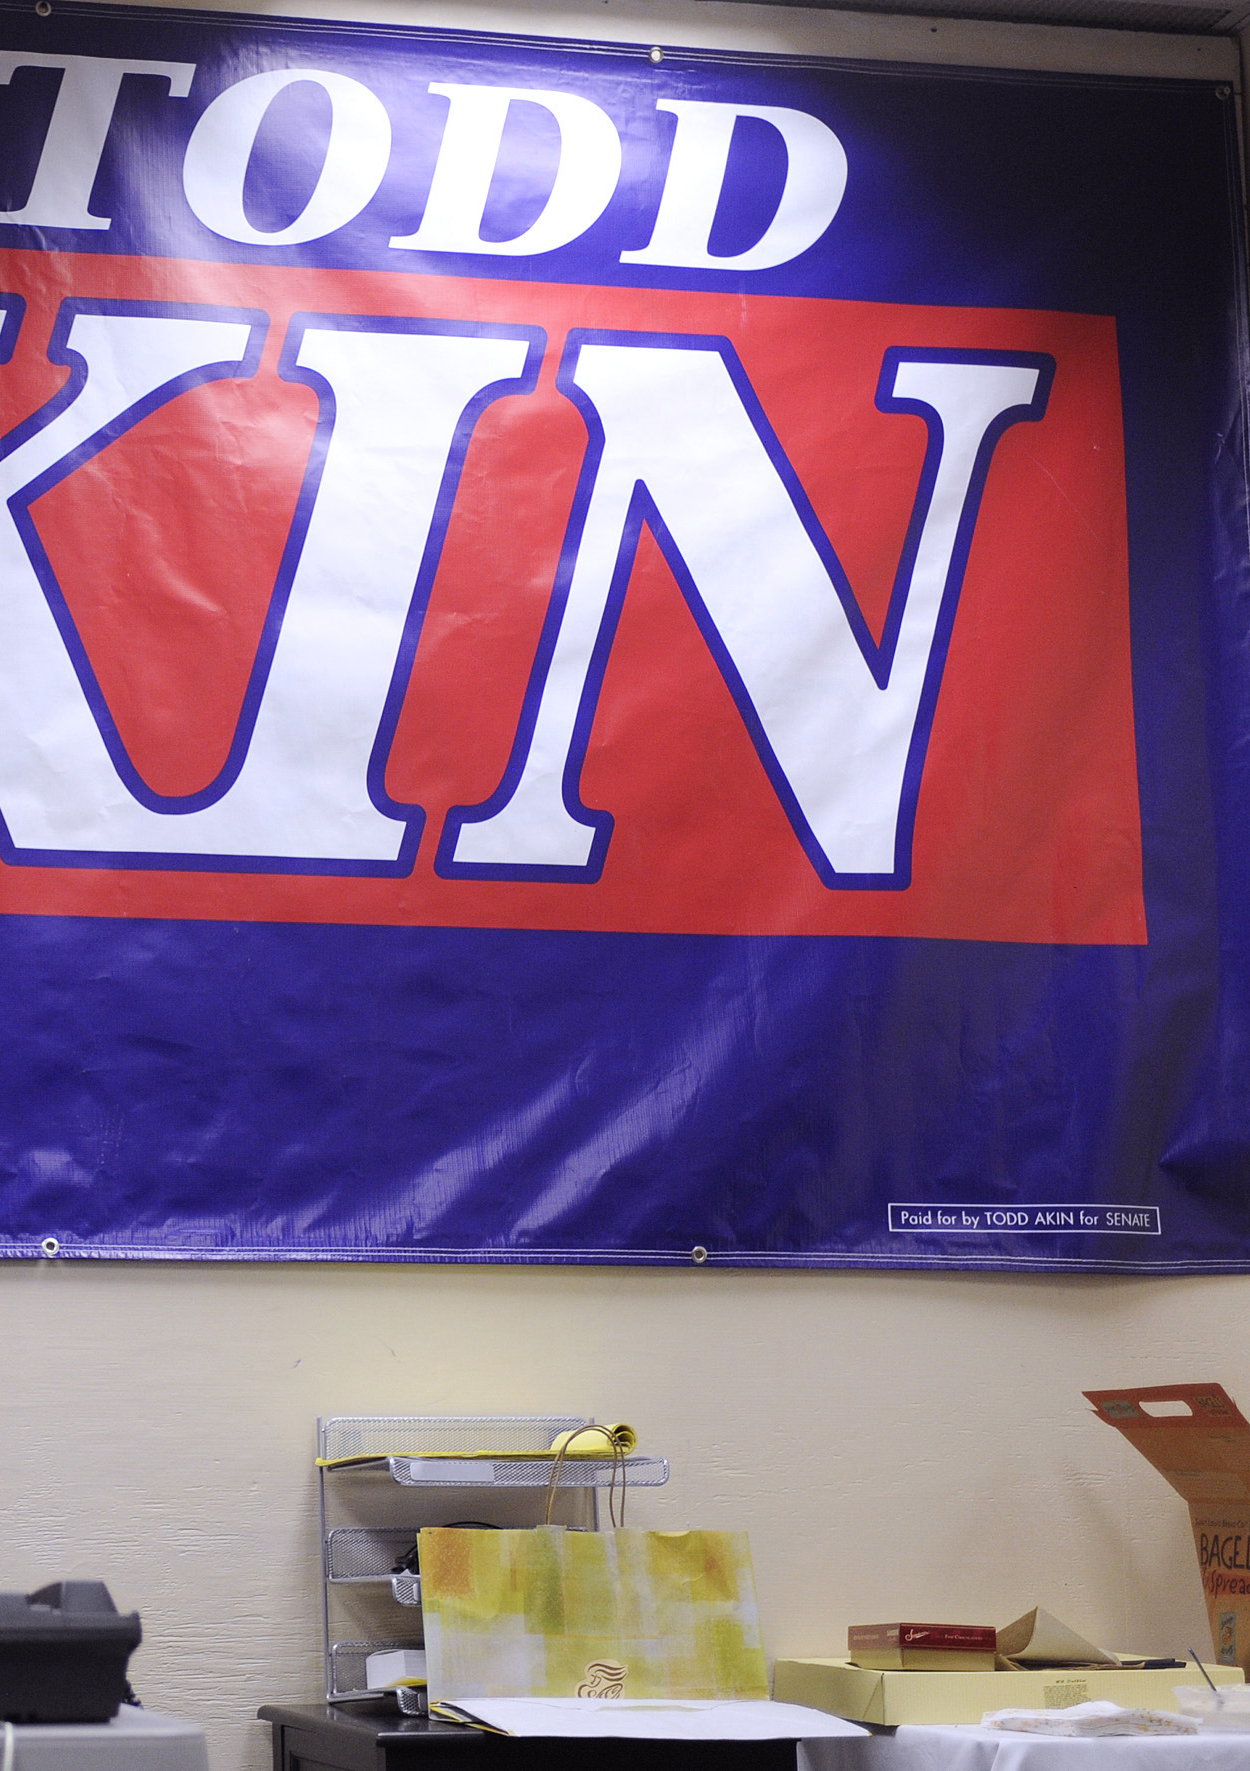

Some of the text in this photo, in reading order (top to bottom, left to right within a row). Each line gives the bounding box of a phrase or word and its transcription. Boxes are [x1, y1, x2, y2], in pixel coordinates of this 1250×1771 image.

[901, 1210, 1151, 1229] Paid for by TODD AKIN for SENATE
